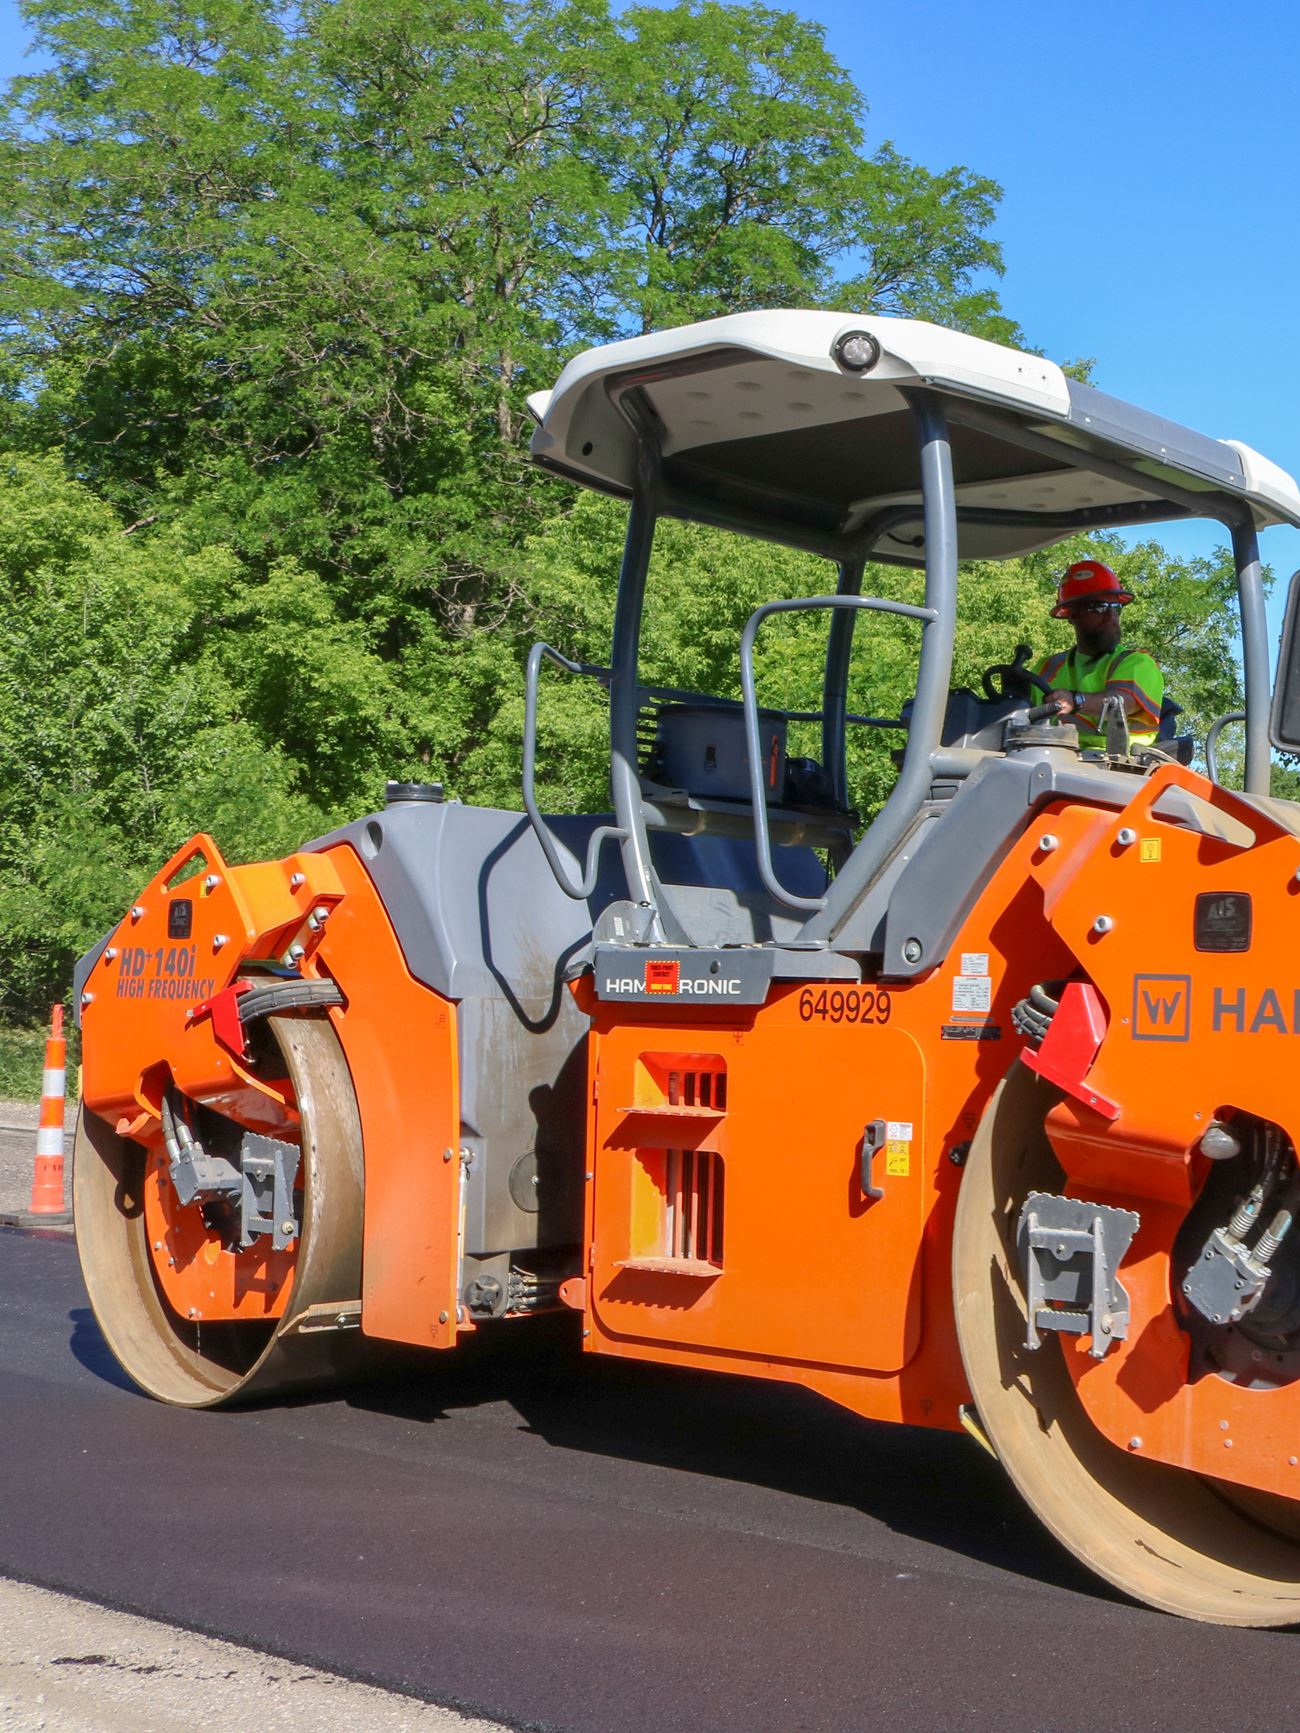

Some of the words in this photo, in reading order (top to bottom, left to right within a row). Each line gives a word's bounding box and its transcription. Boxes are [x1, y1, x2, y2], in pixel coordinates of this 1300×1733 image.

[155, 944, 197, 977] 140i
[116, 978, 145, 998] HIGH
[148, 979, 215, 1000] FREQUENCY
[799, 989, 891, 1025] 649929
